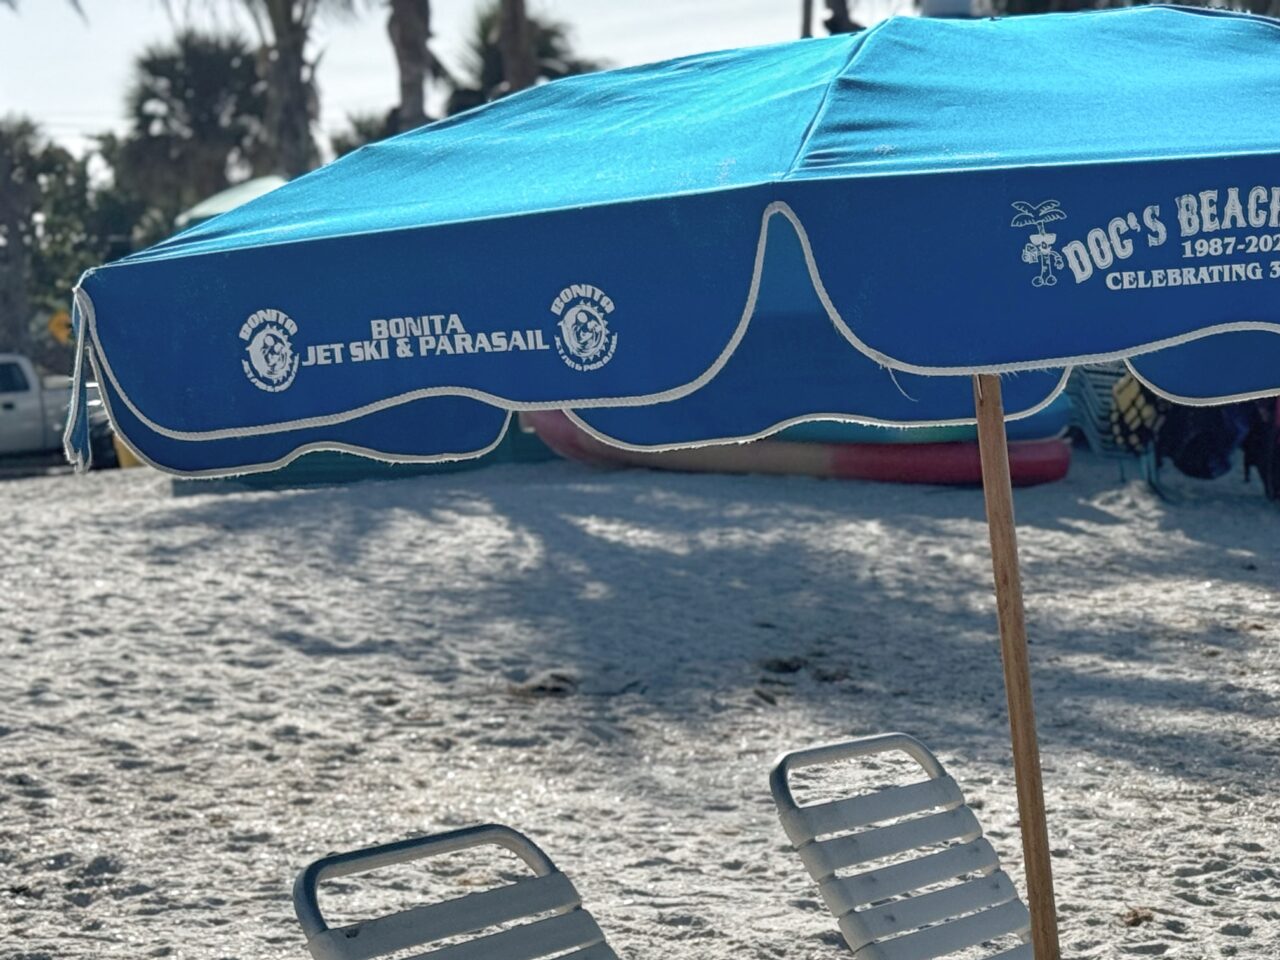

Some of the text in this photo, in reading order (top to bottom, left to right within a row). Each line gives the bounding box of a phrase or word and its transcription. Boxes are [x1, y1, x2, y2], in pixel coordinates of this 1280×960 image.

[1062, 205, 1167, 284] DOC'S
[1105, 263, 1263, 291] CELEBRATING
[550, 283, 616, 316] BONITA
[238, 308, 299, 342] BONITA
[370, 313, 466, 340] BONITA
[301, 329, 550, 367] JET SKI & PARASAIL
